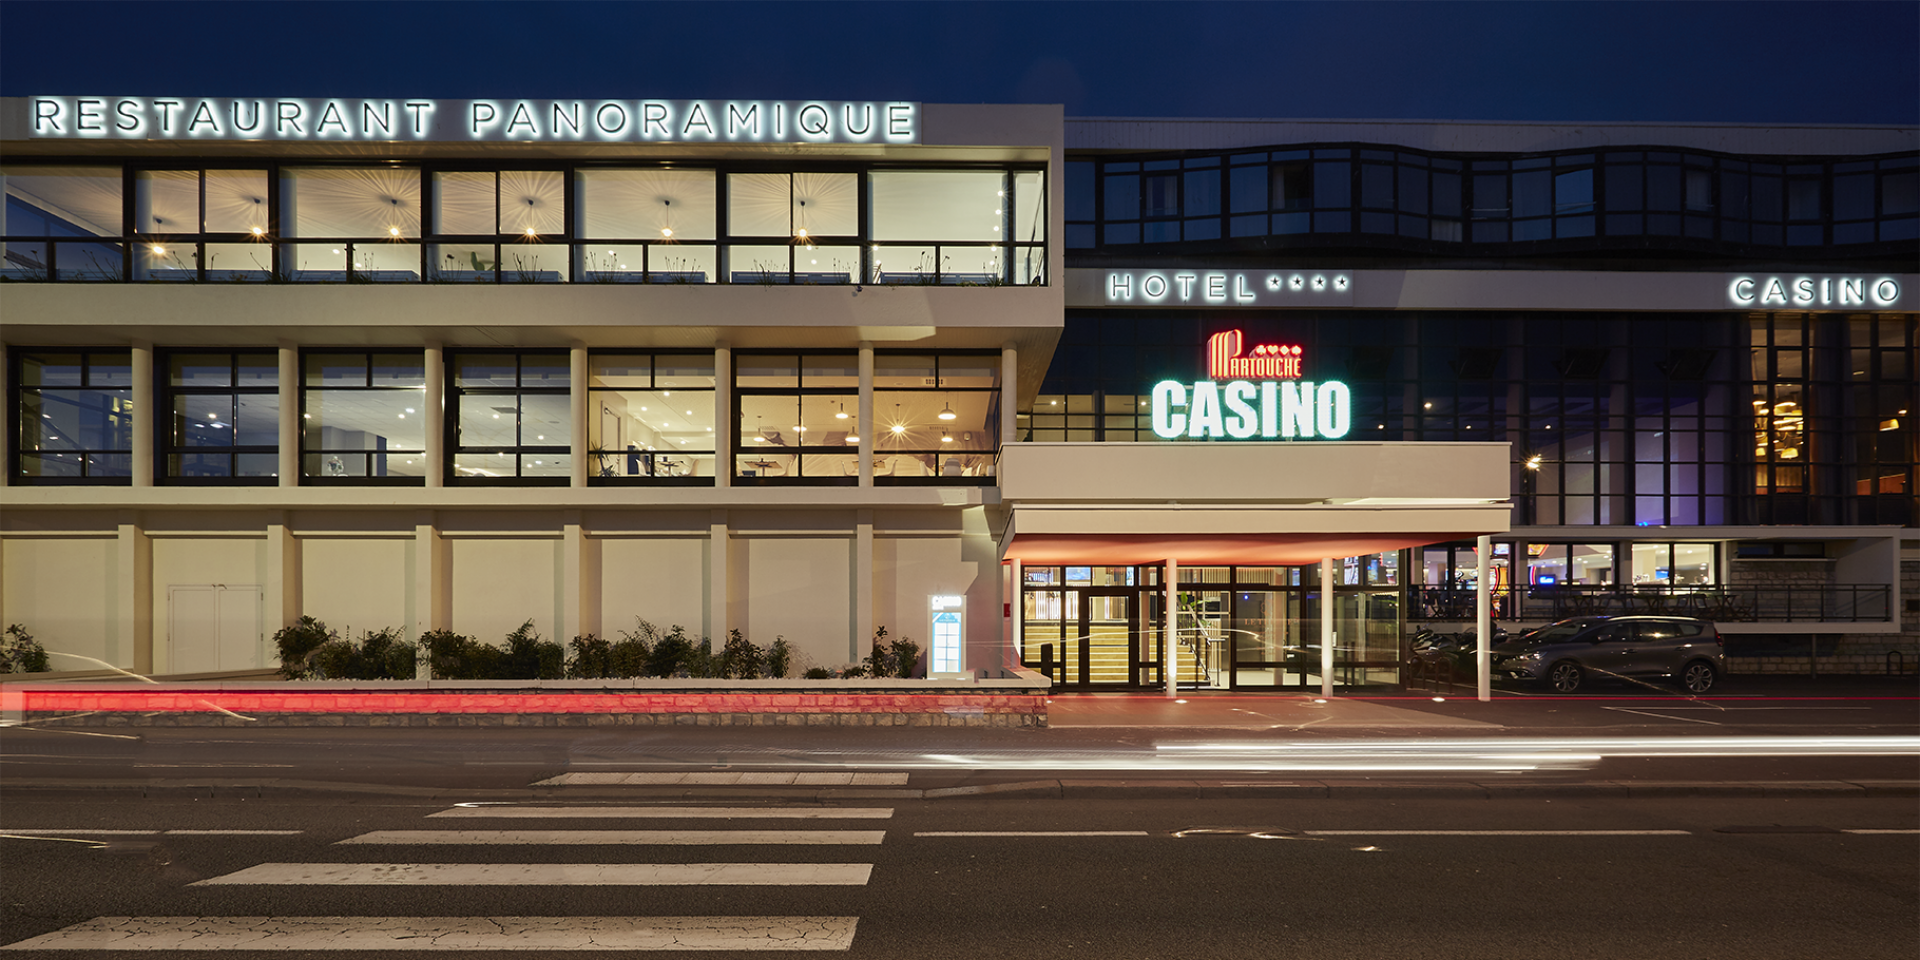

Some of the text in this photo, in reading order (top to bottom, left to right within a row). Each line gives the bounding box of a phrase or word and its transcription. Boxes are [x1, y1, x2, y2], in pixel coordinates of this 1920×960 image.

[35, 100, 910, 135] RESTAURANT PANORAMIQUE
[1112, 275, 1253, 297] HOTEL
[1736, 280, 1899, 302] CASINO
[1209, 329, 1302, 377] PARTOUCHE
[1152, 380, 1350, 438] CASINO
